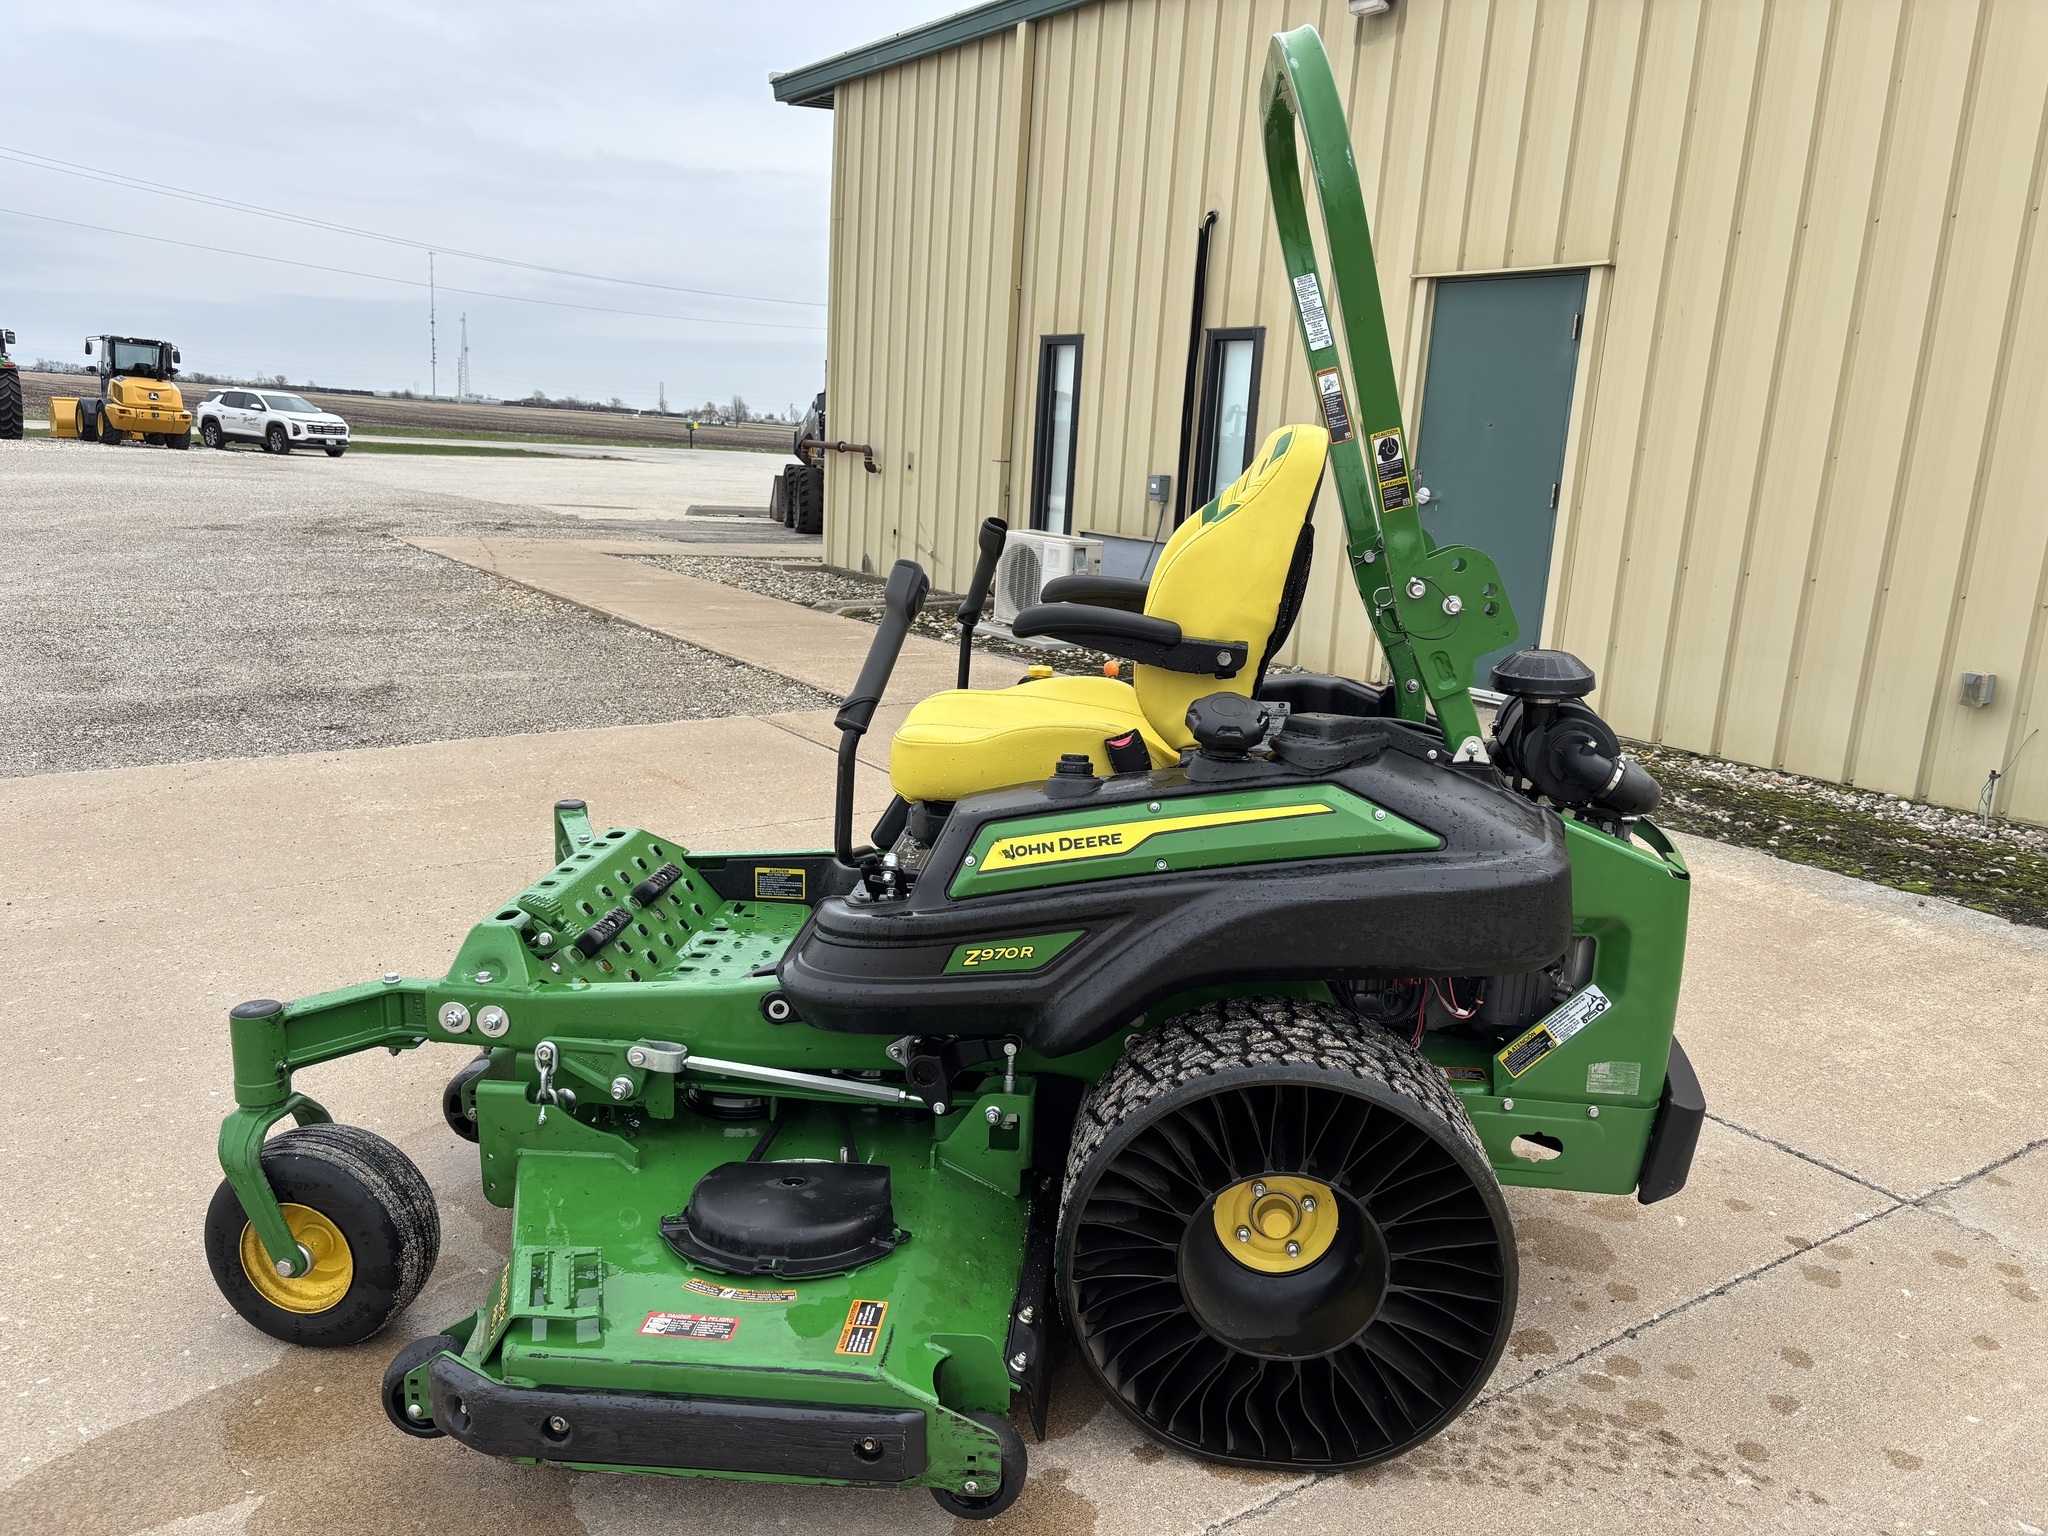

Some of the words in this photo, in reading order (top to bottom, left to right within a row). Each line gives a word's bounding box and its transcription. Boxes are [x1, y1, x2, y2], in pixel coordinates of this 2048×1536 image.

[1376, 428, 1399, 438] CAUTION
[1003, 841, 1055, 861] JOHN
[1058, 833, 1123, 852] DEERE
[963, 946, 1034, 966] Z970R
